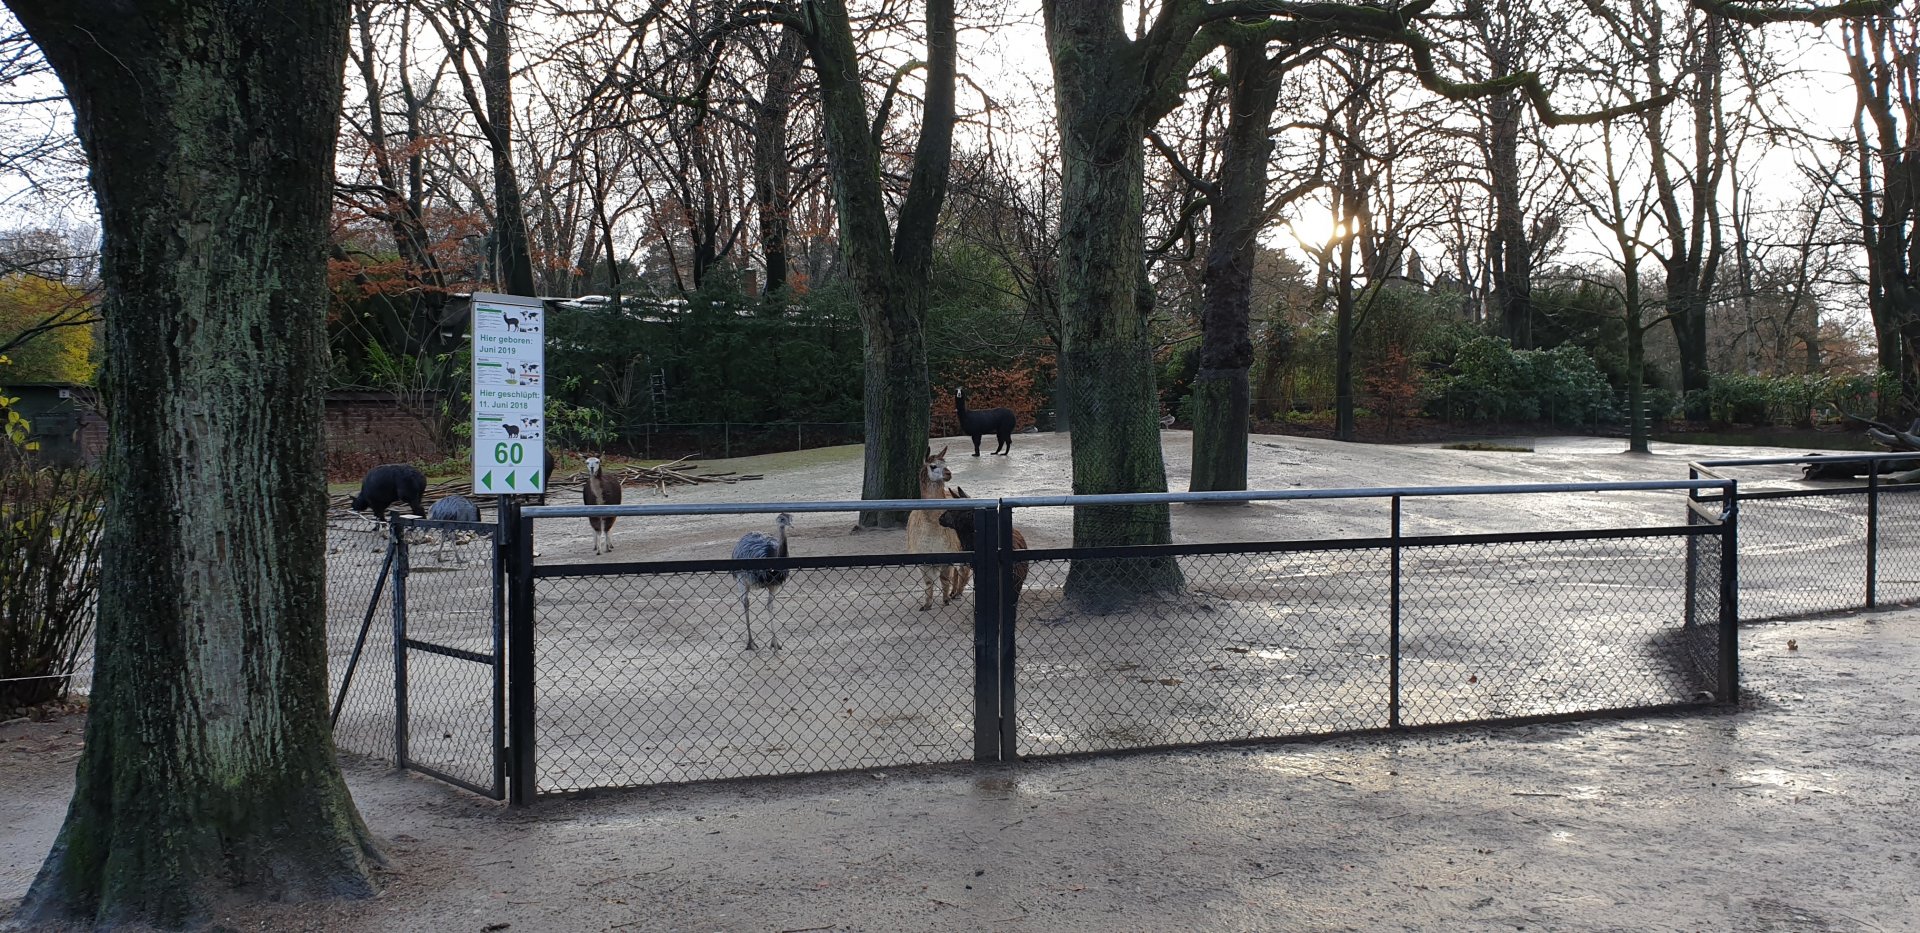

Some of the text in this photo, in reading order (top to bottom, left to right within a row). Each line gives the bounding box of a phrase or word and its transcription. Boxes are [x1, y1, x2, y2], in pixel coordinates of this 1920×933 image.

[480, 334, 533, 344] Hier geboren:
[497, 391, 540, 400] geschlüpft:
[494, 442, 523, 464] 60
